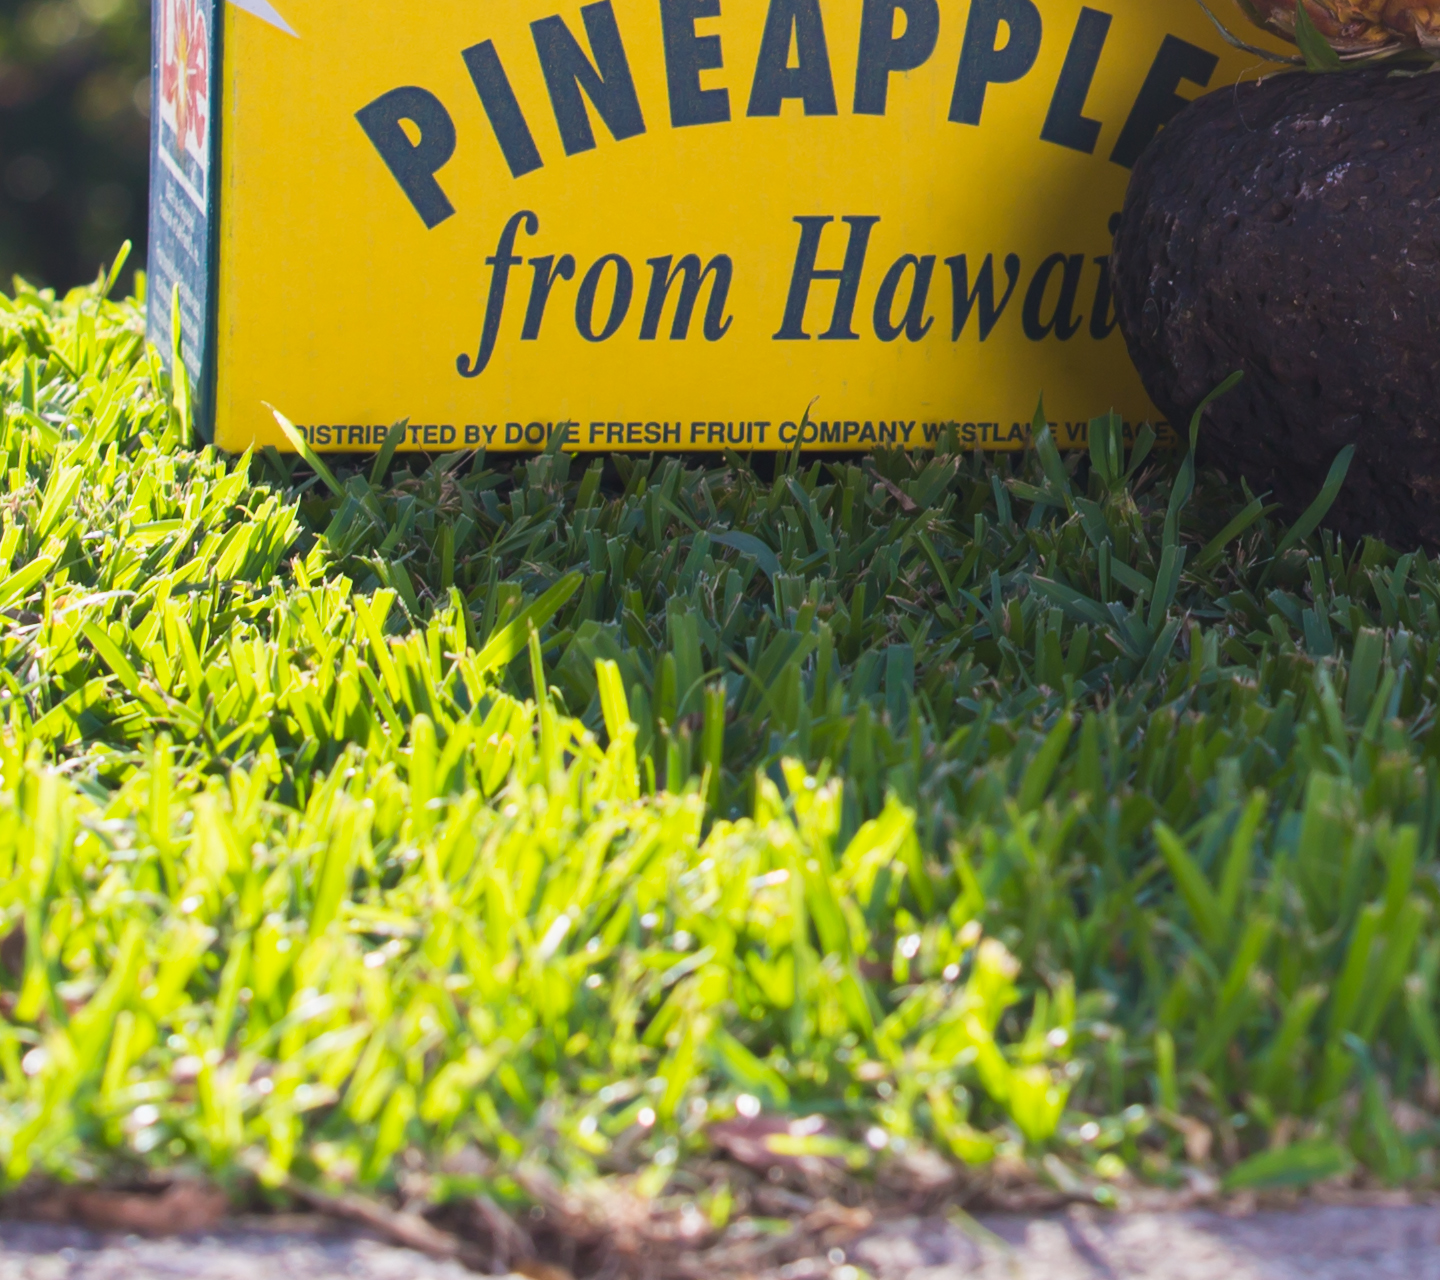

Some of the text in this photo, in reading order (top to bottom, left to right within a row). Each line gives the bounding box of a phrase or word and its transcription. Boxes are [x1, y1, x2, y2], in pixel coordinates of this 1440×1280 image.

[456, 209, 1122, 378] from Hawai
[465, 424, 498, 444] BY
[590, 421, 681, 444] FRESH
[691, 421, 771, 444] FRUIT
[778, 421, 916, 444] COMPANY
